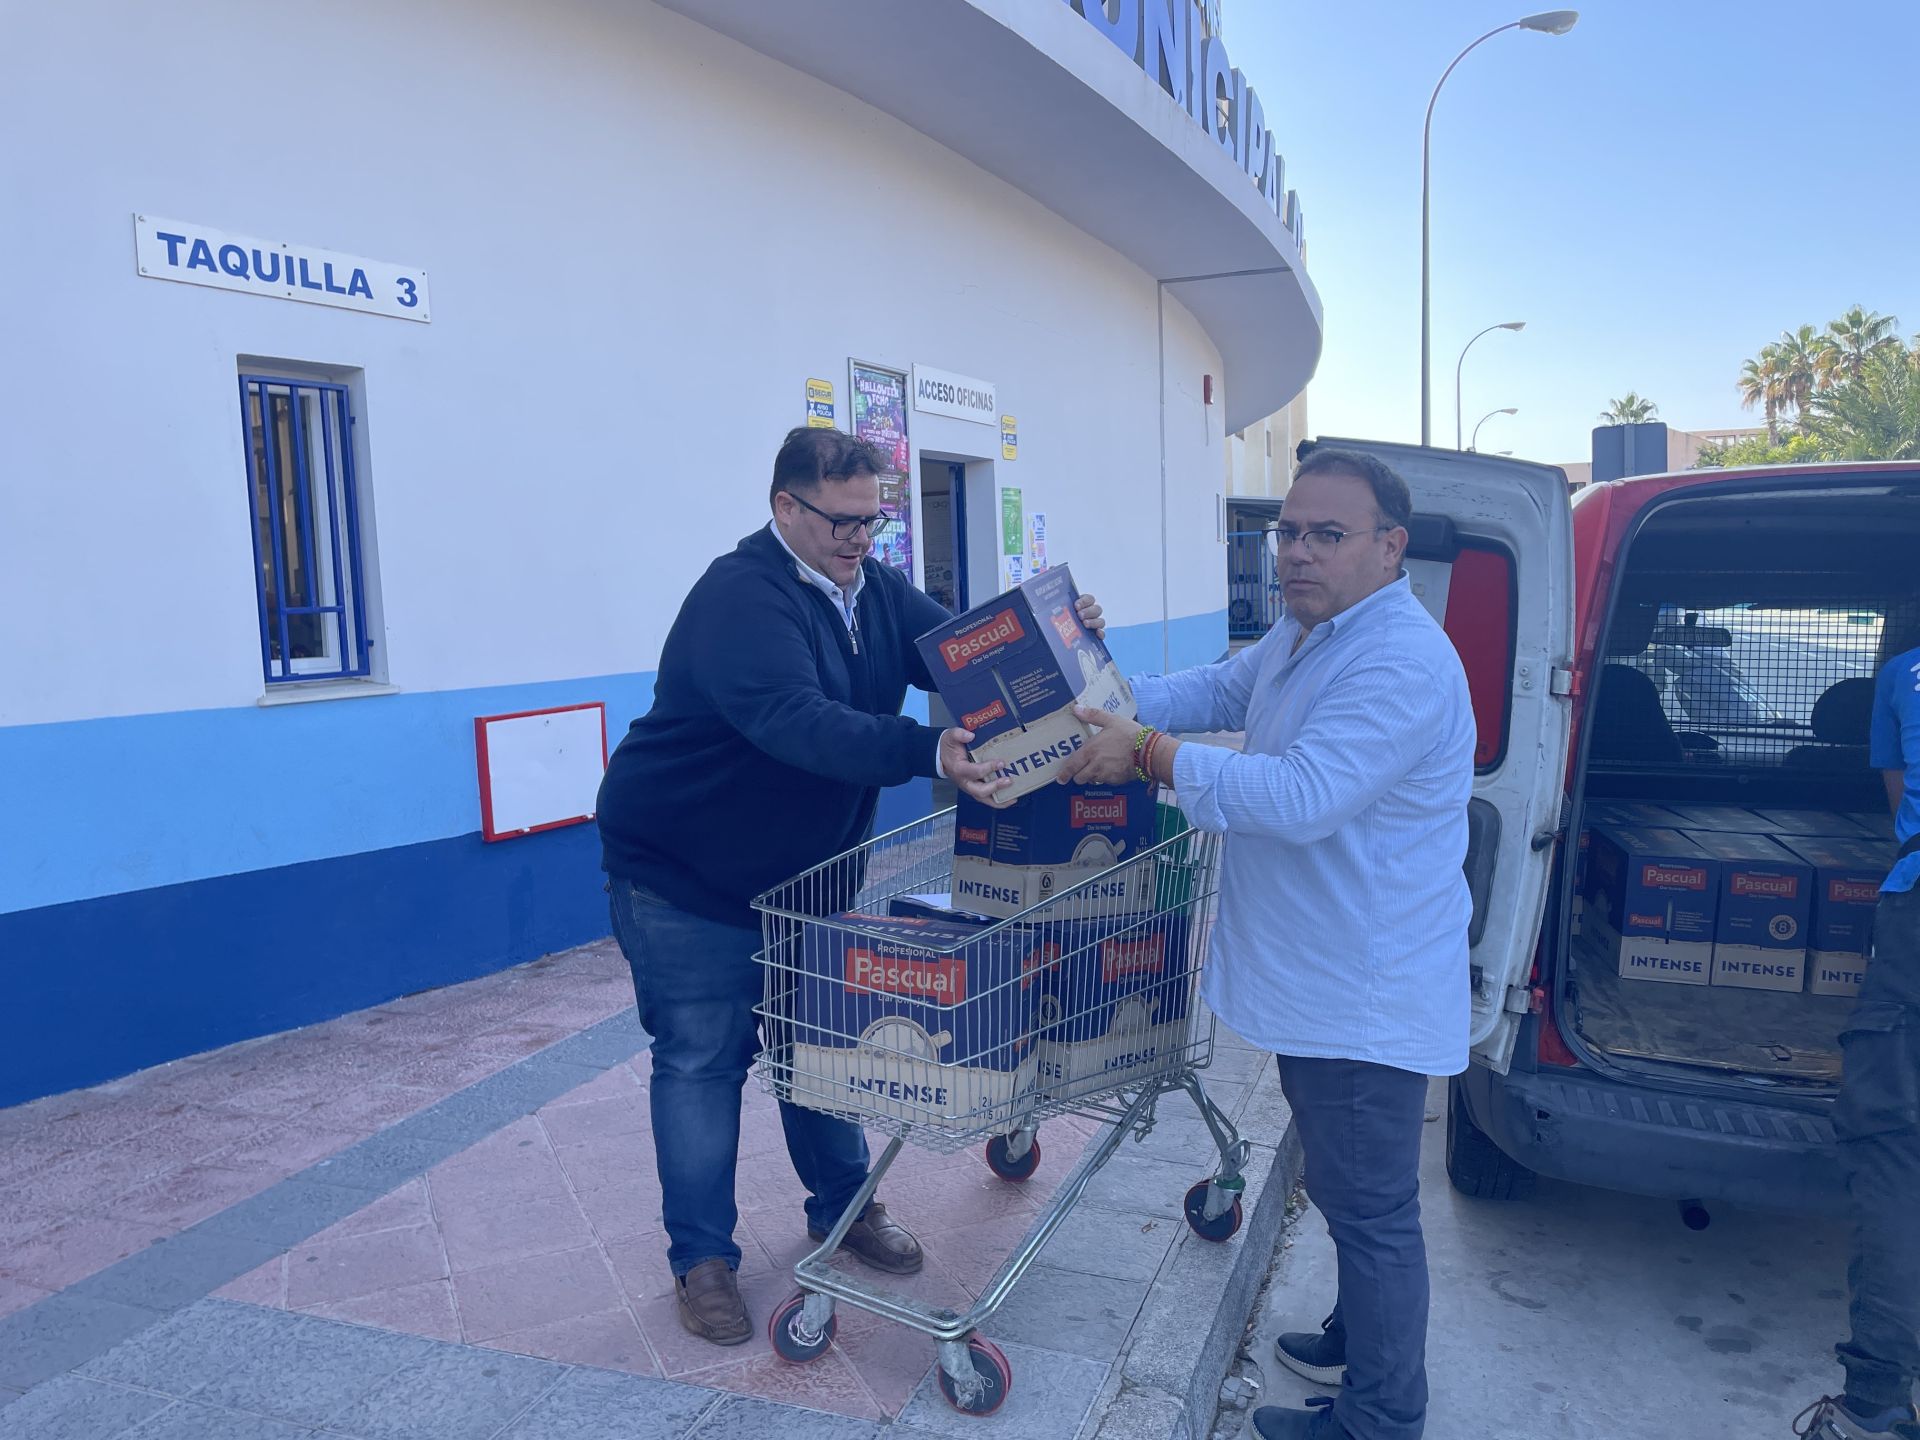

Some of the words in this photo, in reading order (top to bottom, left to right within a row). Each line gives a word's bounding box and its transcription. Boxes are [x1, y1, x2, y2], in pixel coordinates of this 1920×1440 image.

[156, 231, 374, 300] TAQUILLA
[396, 277, 418, 308] 3
[918, 378, 954, 404] ACCESO
[957, 387, 993, 412] OFICINAS
[955, 615, 994, 636] PROFESIONAL
[947, 616, 1016, 662] Pascual
[966, 704, 1002, 727] Pascual
[1075, 800, 1123, 819] Pascual
[1646, 869, 1702, 885] Pascual
[1736, 877, 1793, 893] Pascual
[959, 879, 1020, 905] INTENSE
[1835, 884, 1879, 898] Pascu
[877, 944, 936, 959] PROFESIONAL
[1630, 955, 1703, 973] INTENSE
[1721, 960, 1796, 978] INTENSE
[855, 956, 956, 993] Pascual
[1822, 970, 1864, 984] INTE
[850, 1076, 948, 1106] INTENSE
